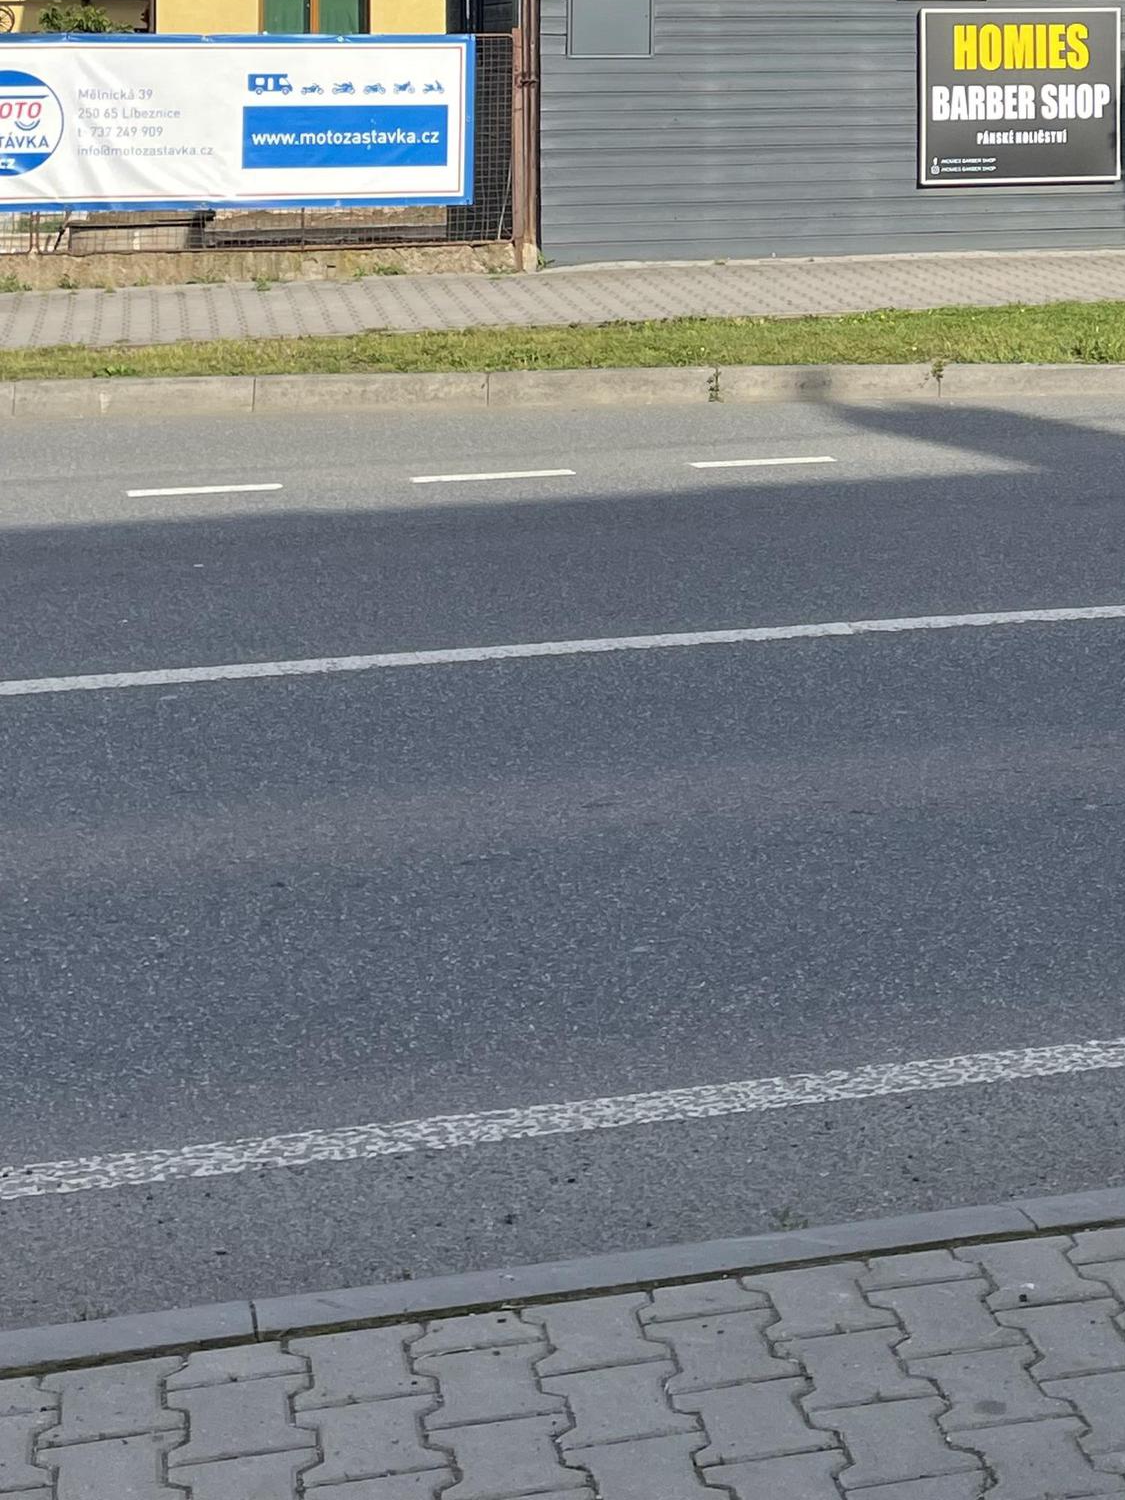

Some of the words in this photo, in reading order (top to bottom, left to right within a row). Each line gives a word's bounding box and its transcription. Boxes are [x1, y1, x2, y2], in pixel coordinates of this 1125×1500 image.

[953, 23, 1089, 70] HOMIES
[78, 88, 135, 100] Mělnická
[138, 89, 153, 100] 39
[932, 84, 1036, 121] BARBER
[1040, 83, 1110, 120] SHOP
[78, 107, 100, 119] 250
[103, 107, 119, 119] 65
[90, 126, 112, 138] 737
[116, 126, 138, 137] 249
[141, 126, 163, 137] 909
[251, 128, 440, 146] www.motozastavka.cz
[976, 129, 1014, 145] PÁNSKÉ
[1015, 128, 1067, 144] HOLIČSTVÍ
